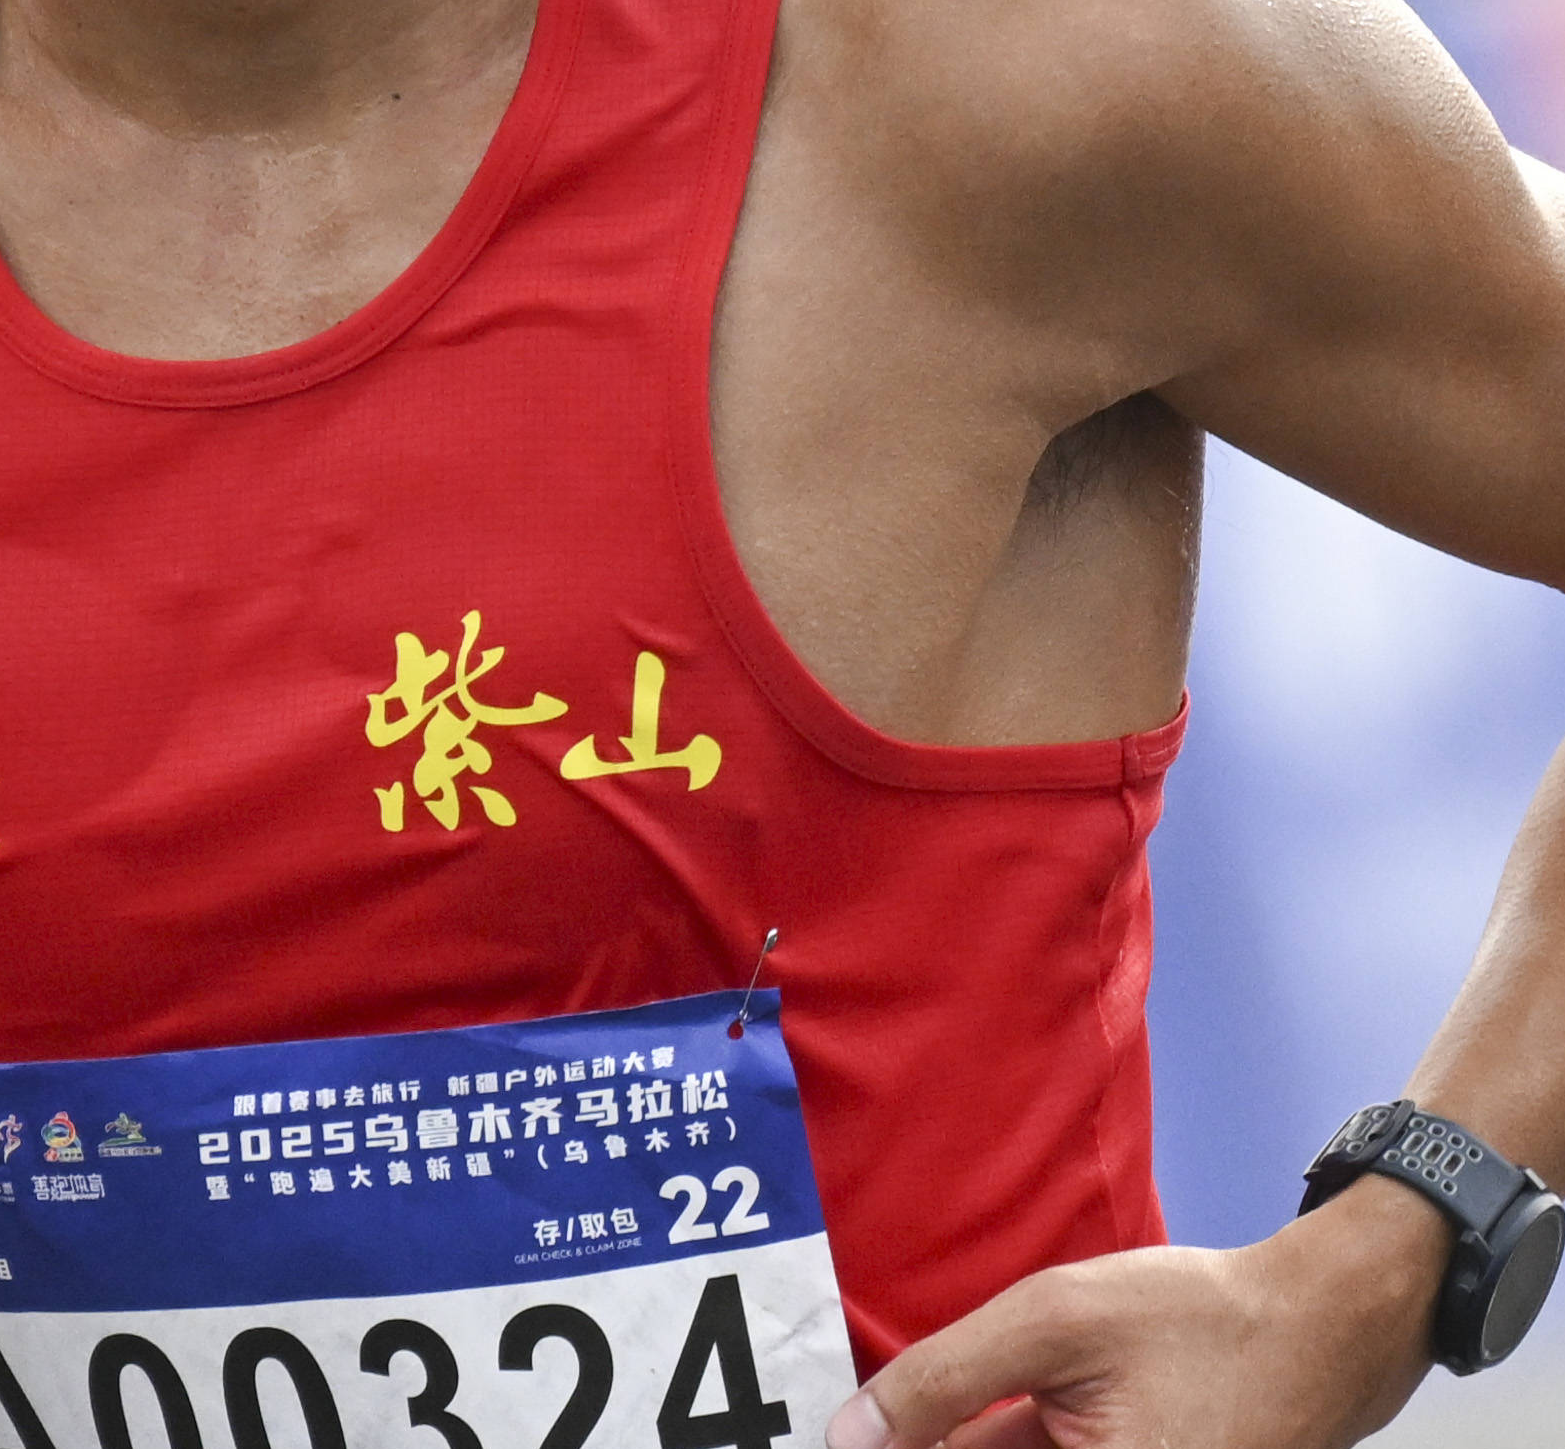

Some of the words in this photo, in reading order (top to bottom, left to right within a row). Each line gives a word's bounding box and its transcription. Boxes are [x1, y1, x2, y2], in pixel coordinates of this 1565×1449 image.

[365, 610, 722, 832] 紫山
[198, 1070, 730, 1166] 2025乌鲁木齐马拉松
[233, 1080, 421, 1117] 跟着赛事去旅行
[448, 1046, 675, 1096] 新疆户外运动大赛
[533, 1207, 639, 1247] 存/取包
[659, 1166, 770, 1245] 22
[514, 1252, 539, 1265] GEAR
[541, 1249, 572, 1261] CHECK
[585, 1242, 615, 1255] CLAIM
